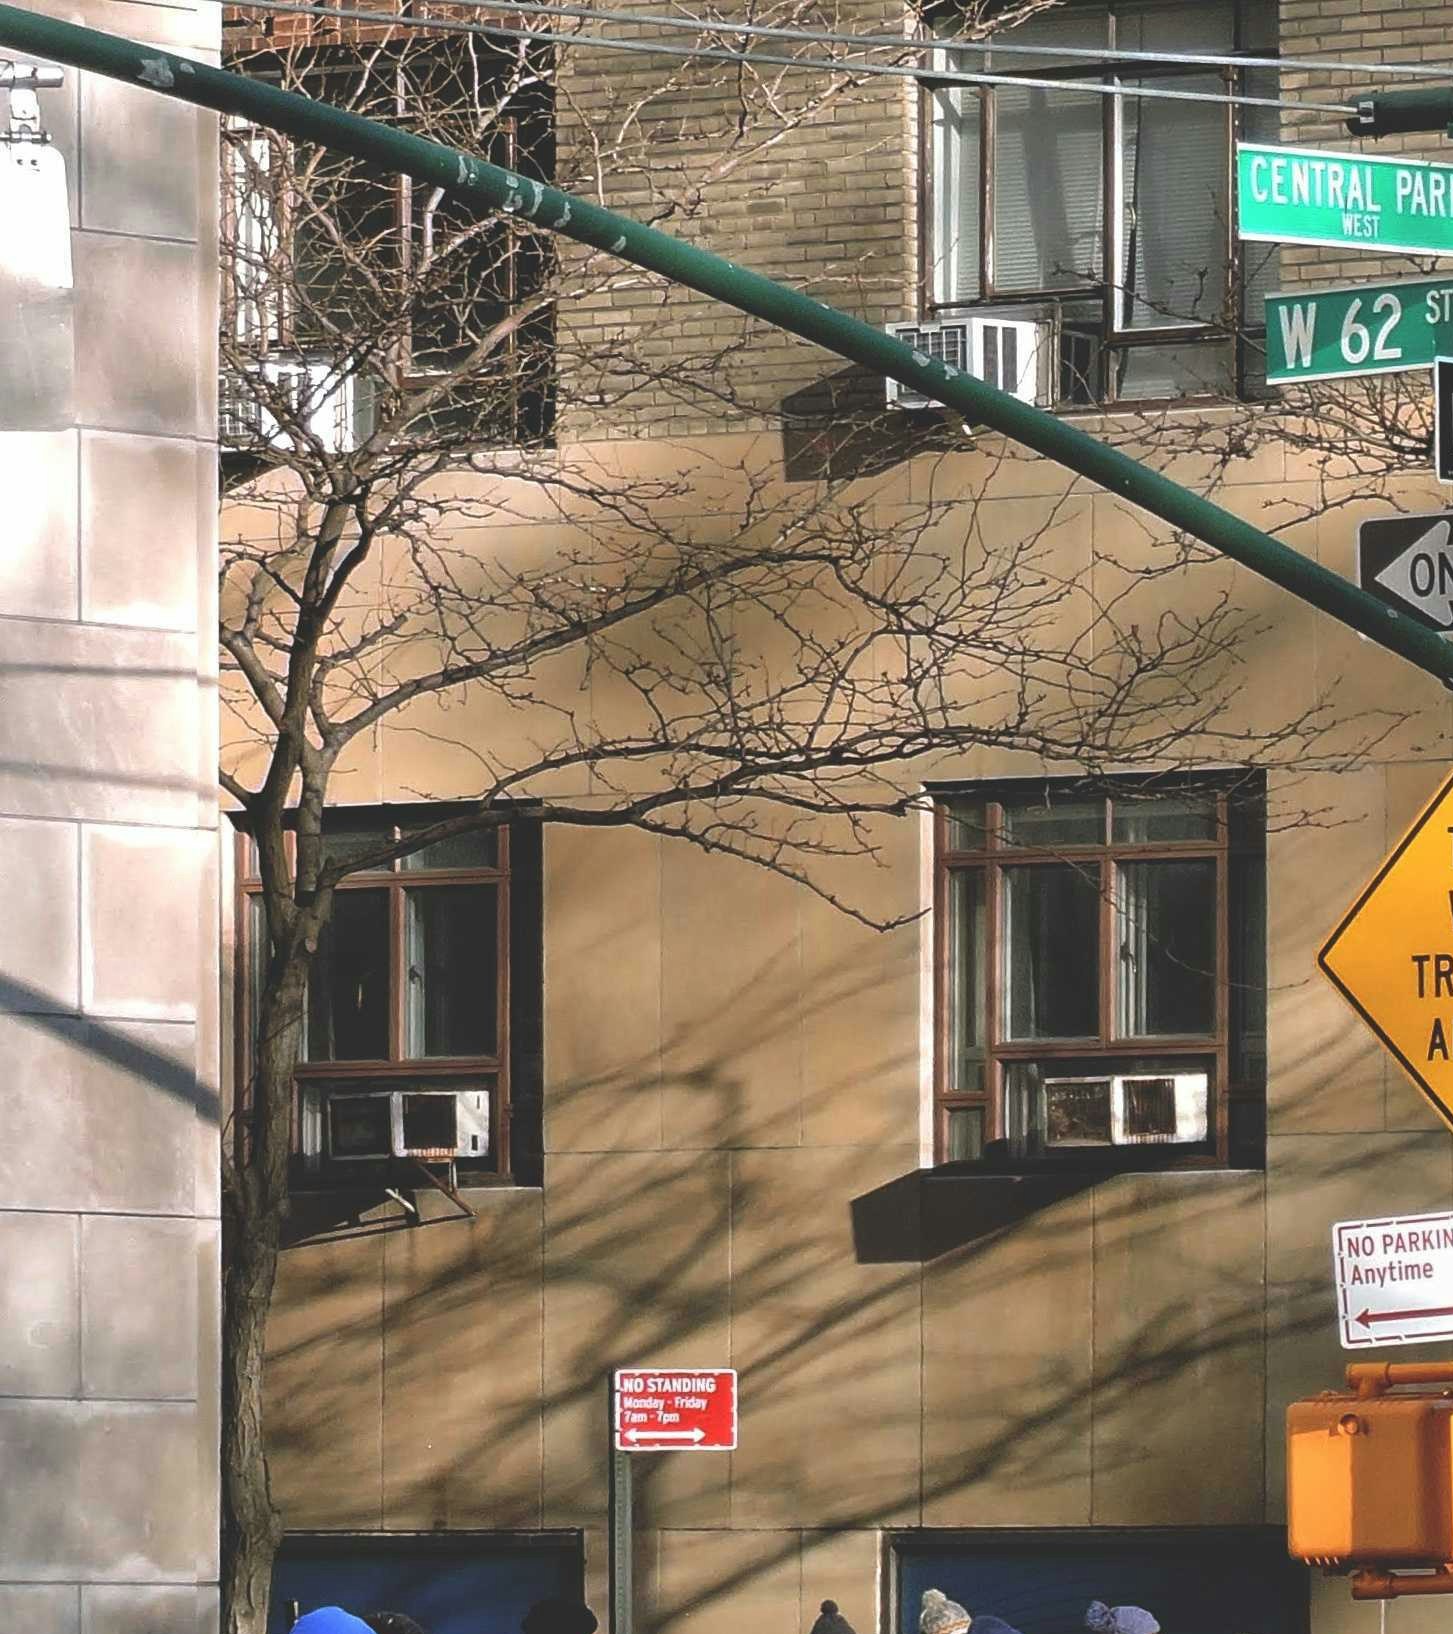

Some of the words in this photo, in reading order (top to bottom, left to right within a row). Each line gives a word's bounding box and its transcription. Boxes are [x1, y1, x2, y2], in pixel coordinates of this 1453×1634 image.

[1249, 154, 1382, 213] CENTRAL
[1341, 213, 1381, 239] WEST
[1278, 301, 1318, 370] W
[1339, 294, 1403, 365] 62
[1347, 1235, 1375, 1258] NO
[1351, 1260, 1434, 1288] Anytime
[623, 1378, 645, 1393] NO
[647, 1377, 717, 1393] STANDING
[623, 1396, 665, 1410] Monday
[674, 1396, 709, 1411] Friday
[624, 1410, 649, 1423] 7am
